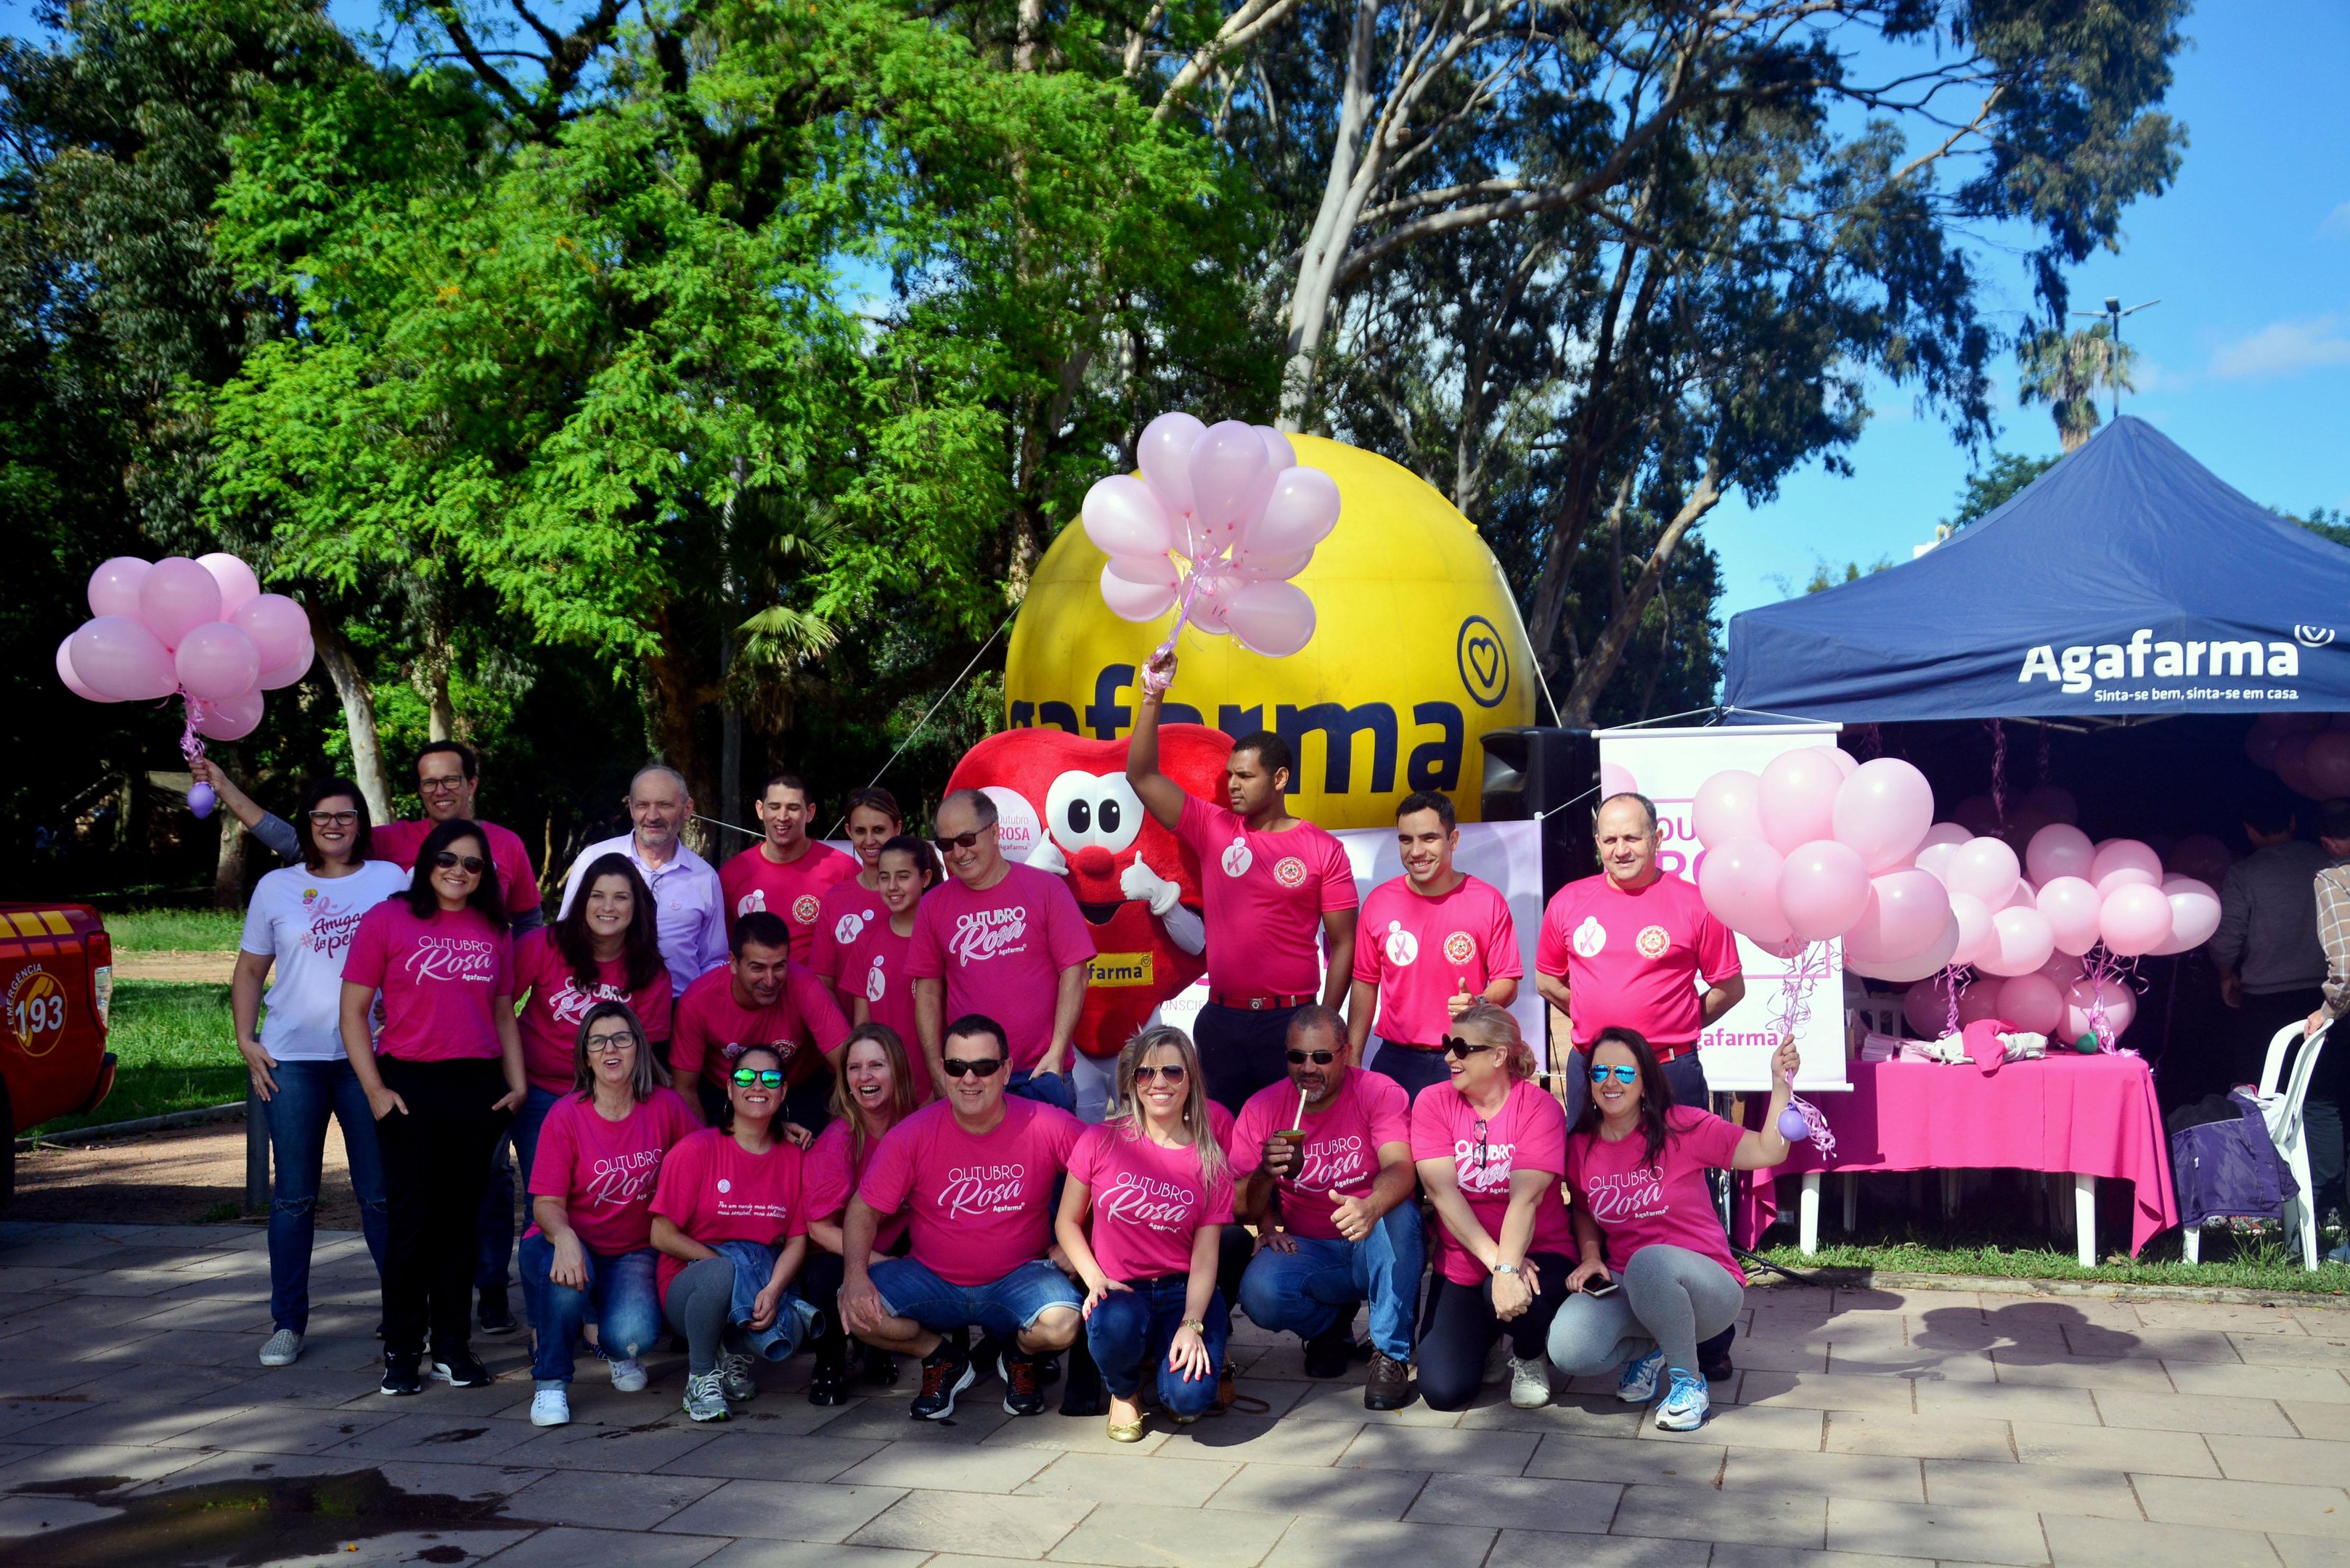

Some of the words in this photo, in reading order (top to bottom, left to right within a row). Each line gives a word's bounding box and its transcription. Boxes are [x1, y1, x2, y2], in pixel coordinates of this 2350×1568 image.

[2018, 629, 2299, 695] Agafarma
[2094, 689, 2149, 703] Sinta-se
[2151, 687, 2184, 701] bem,
[2186, 686, 2240, 700] sinta-se
[2243, 689, 2264, 700] em
[998, 827, 1030, 841] ROSA
[311, 912, 364, 935] Amiga
[956, 906, 1026, 930] OUTUBRO
[418, 935, 493, 954] OUTUBRO
[949, 920, 1027, 967] Rosa
[998, 946, 1024, 956] Agafarma
[404, 944, 493, 986] Rosa
[461, 973, 491, 983] Agafarma
[7, 963, 42, 1025] EMERGÊNCIA
[15, 995, 63, 1035] 193
[948, 1164, 1024, 1183] OUTUBRO
[1279, 1151, 1364, 1193] Rosa
[1334, 1175, 1365, 1188] Agafarma
[1588, 1166, 1664, 1190] OUTUBRO
[937, 1177, 1025, 1220] Rosa
[1116, 1172, 1194, 1205] OUTUBRO
[992, 1204, 1022, 1213] Agafarma
[1098, 1184, 1191, 1224] Rosa
[1588, 1182, 1665, 1225] Rosa
[1634, 1208, 1666, 1219] Agafarma
